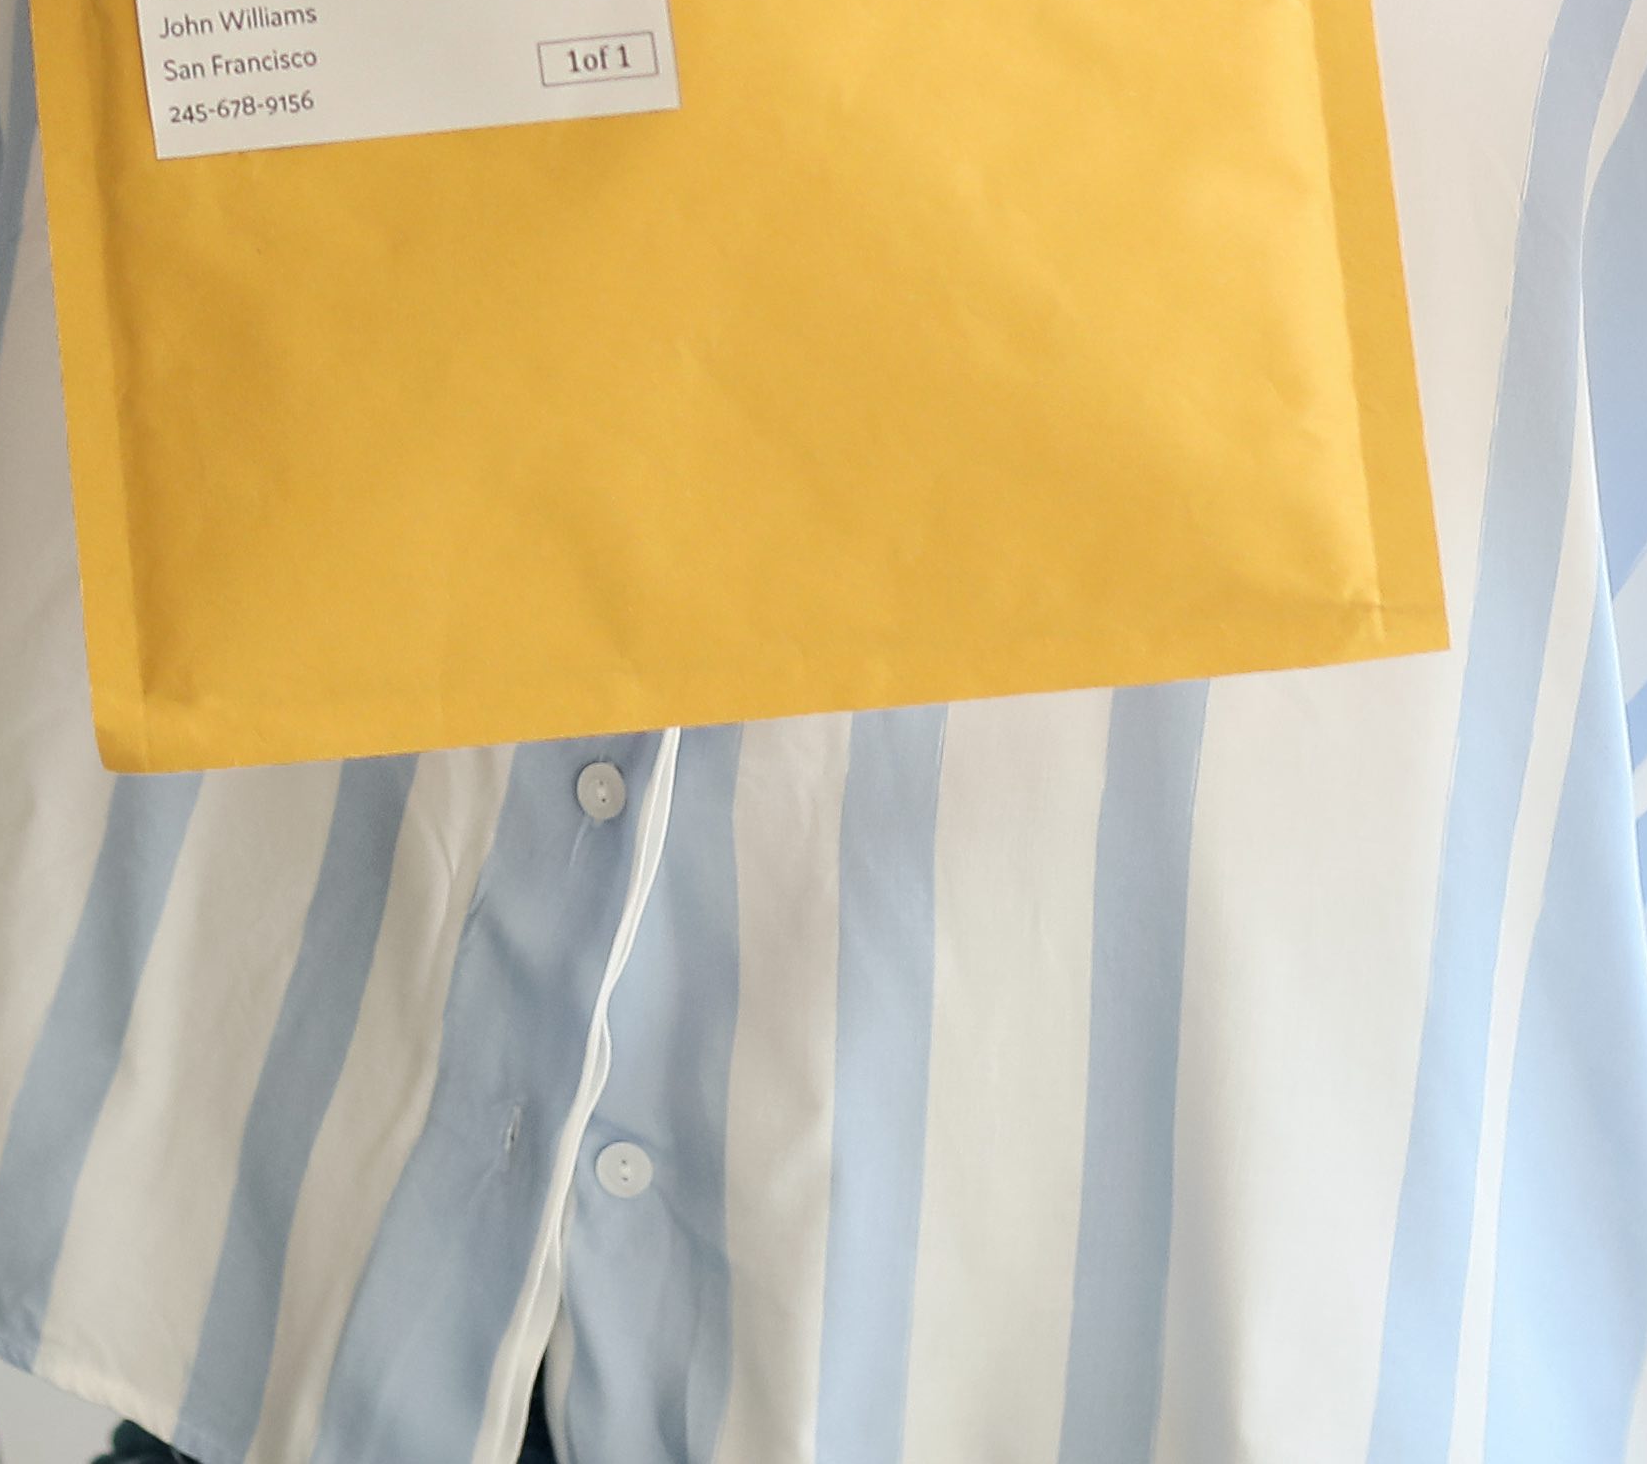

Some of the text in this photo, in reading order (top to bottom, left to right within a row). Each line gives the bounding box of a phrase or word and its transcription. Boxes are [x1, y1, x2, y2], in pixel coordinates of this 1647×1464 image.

[160, 7, 317, 38] John Williams
[164, 50, 317, 81] San Francisco
[169, 90, 314, 123] 245-678-9156
